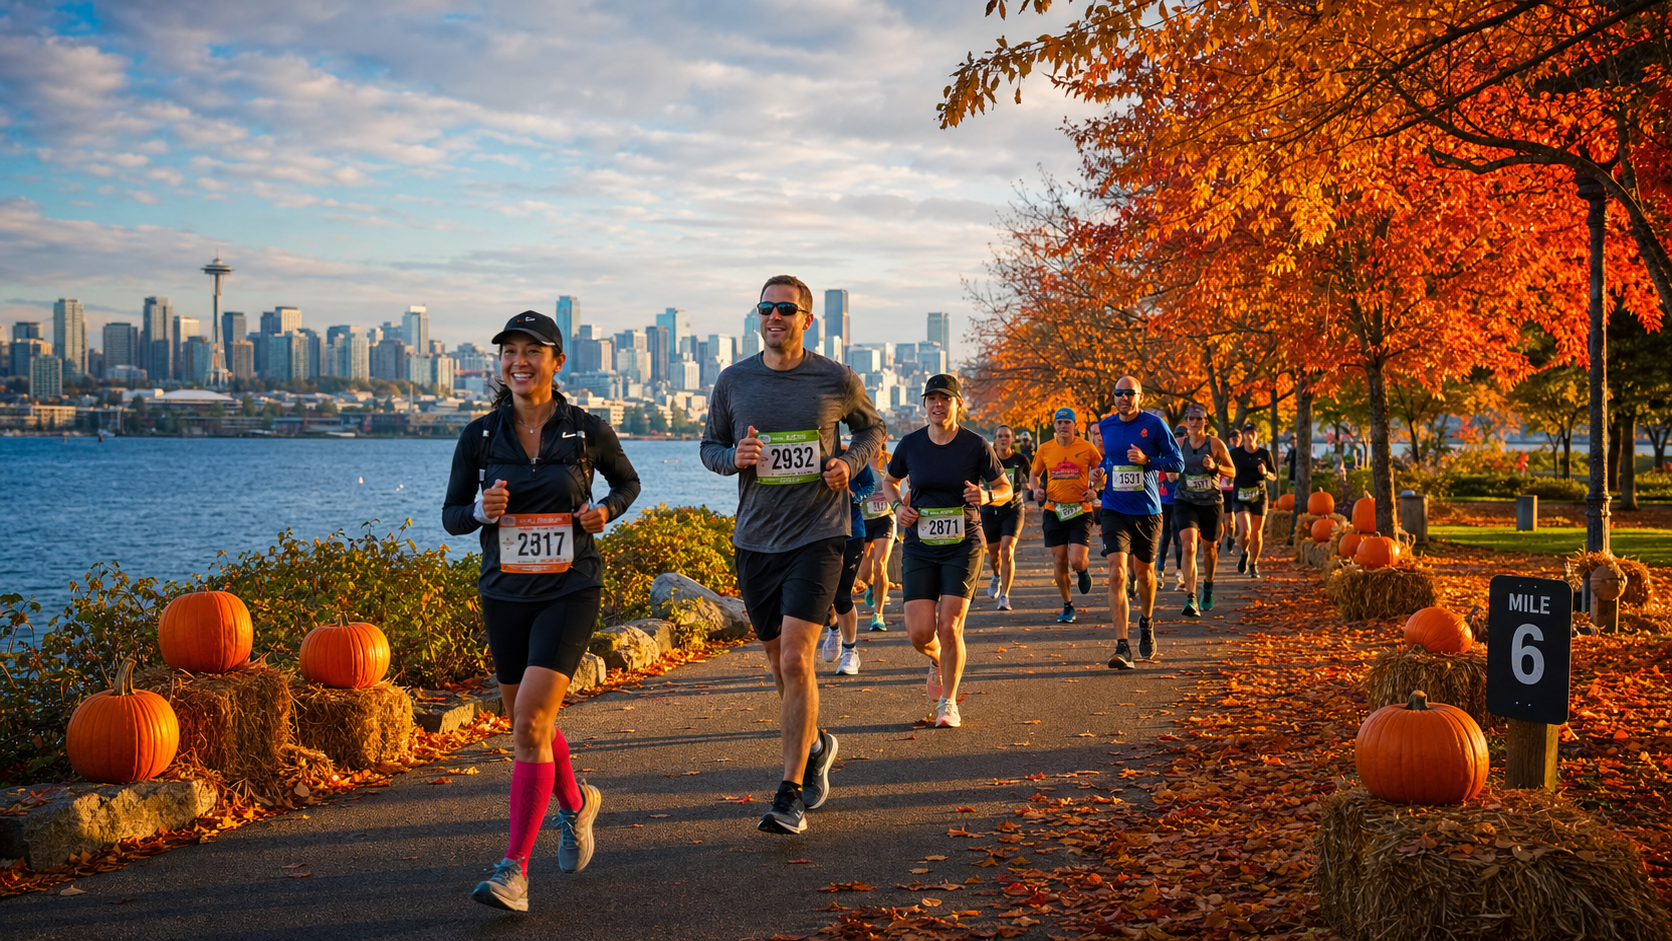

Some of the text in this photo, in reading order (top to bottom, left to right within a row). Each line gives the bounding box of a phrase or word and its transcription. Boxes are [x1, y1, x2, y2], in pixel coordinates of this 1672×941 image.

[771, 446, 814, 470] 2932
[929, 519, 958, 535] 2871
[1508, 592, 1551, 615] MILE
[1511, 623, 1545, 685] 6
